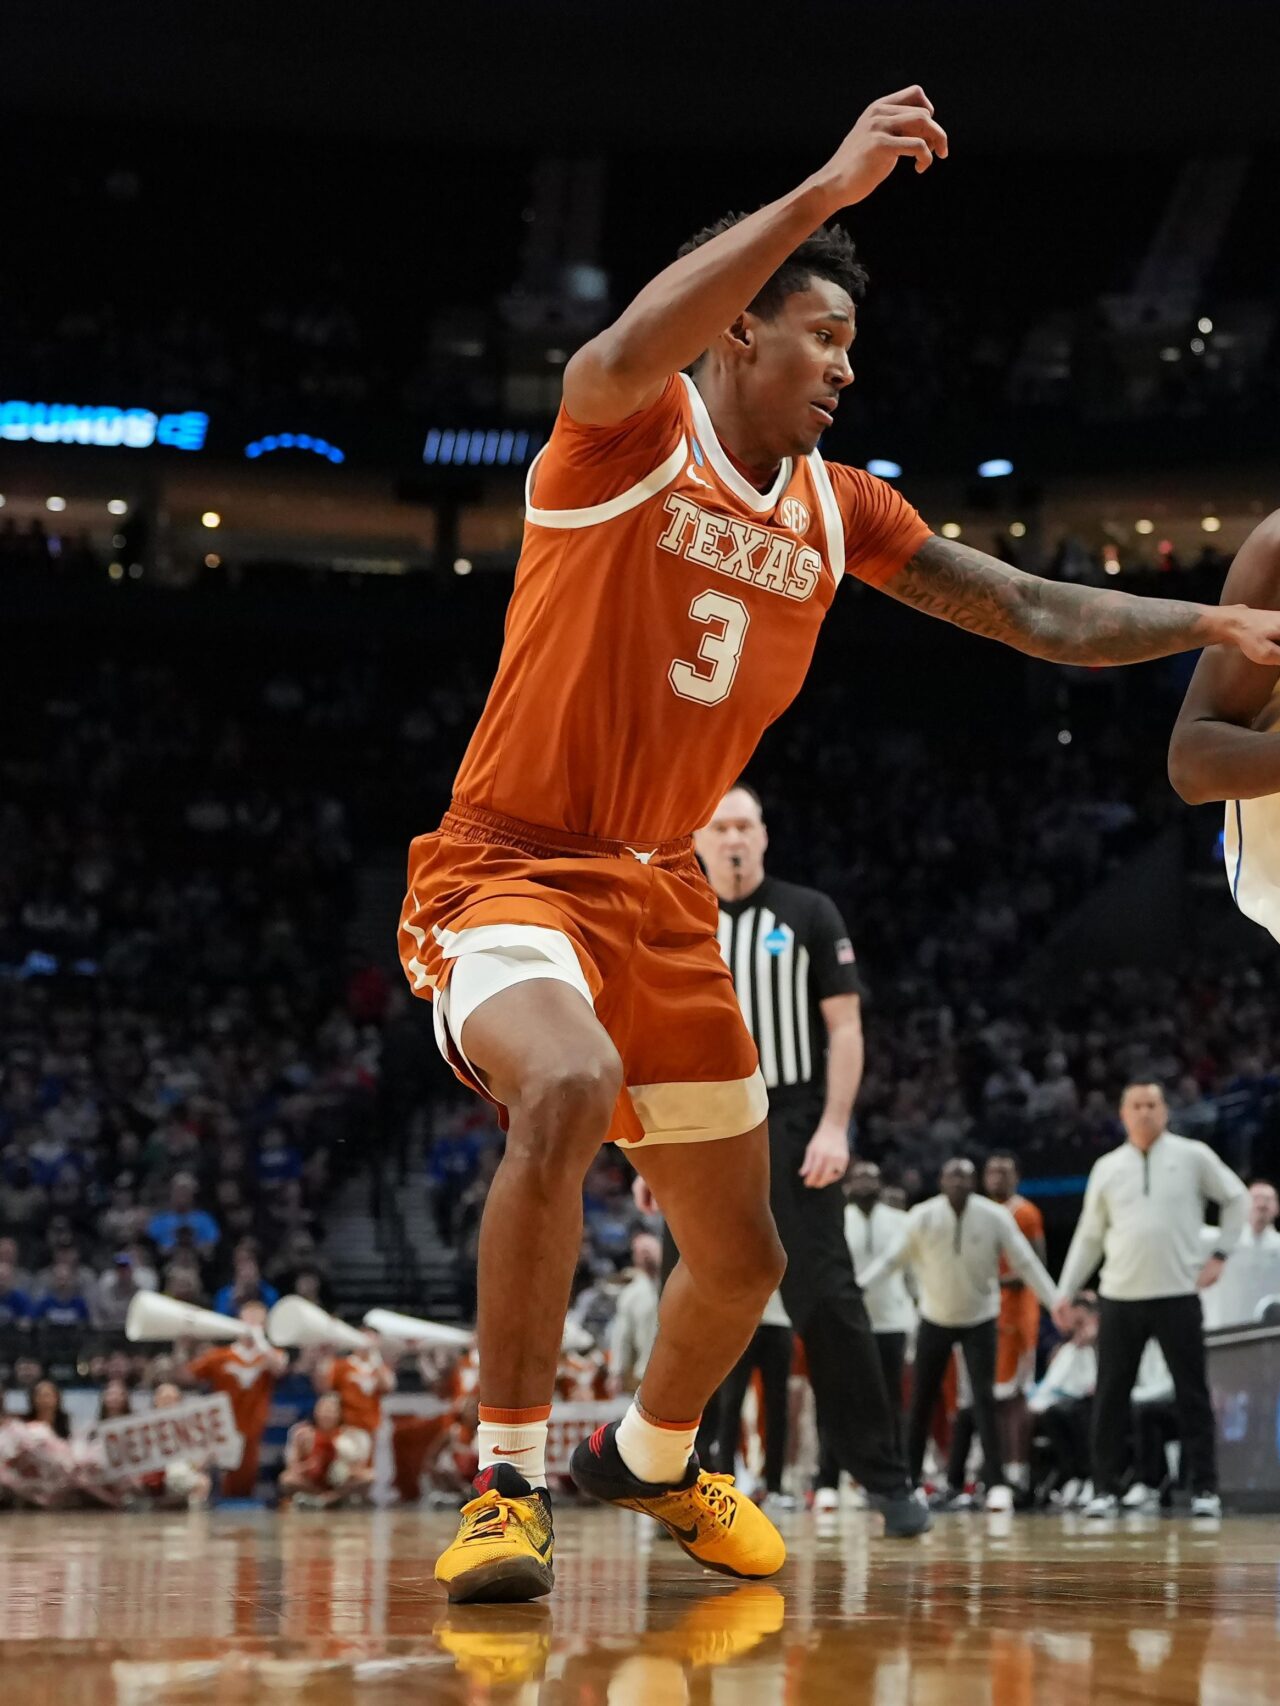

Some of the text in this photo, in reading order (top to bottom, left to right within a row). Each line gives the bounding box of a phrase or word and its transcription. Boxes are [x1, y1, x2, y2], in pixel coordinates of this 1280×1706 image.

[657, 492, 822, 602] TEXAS
[782, 499, 809, 535] SEC
[668, 588, 750, 707] 3
[105, 1407, 228, 1468] DEFENSE
